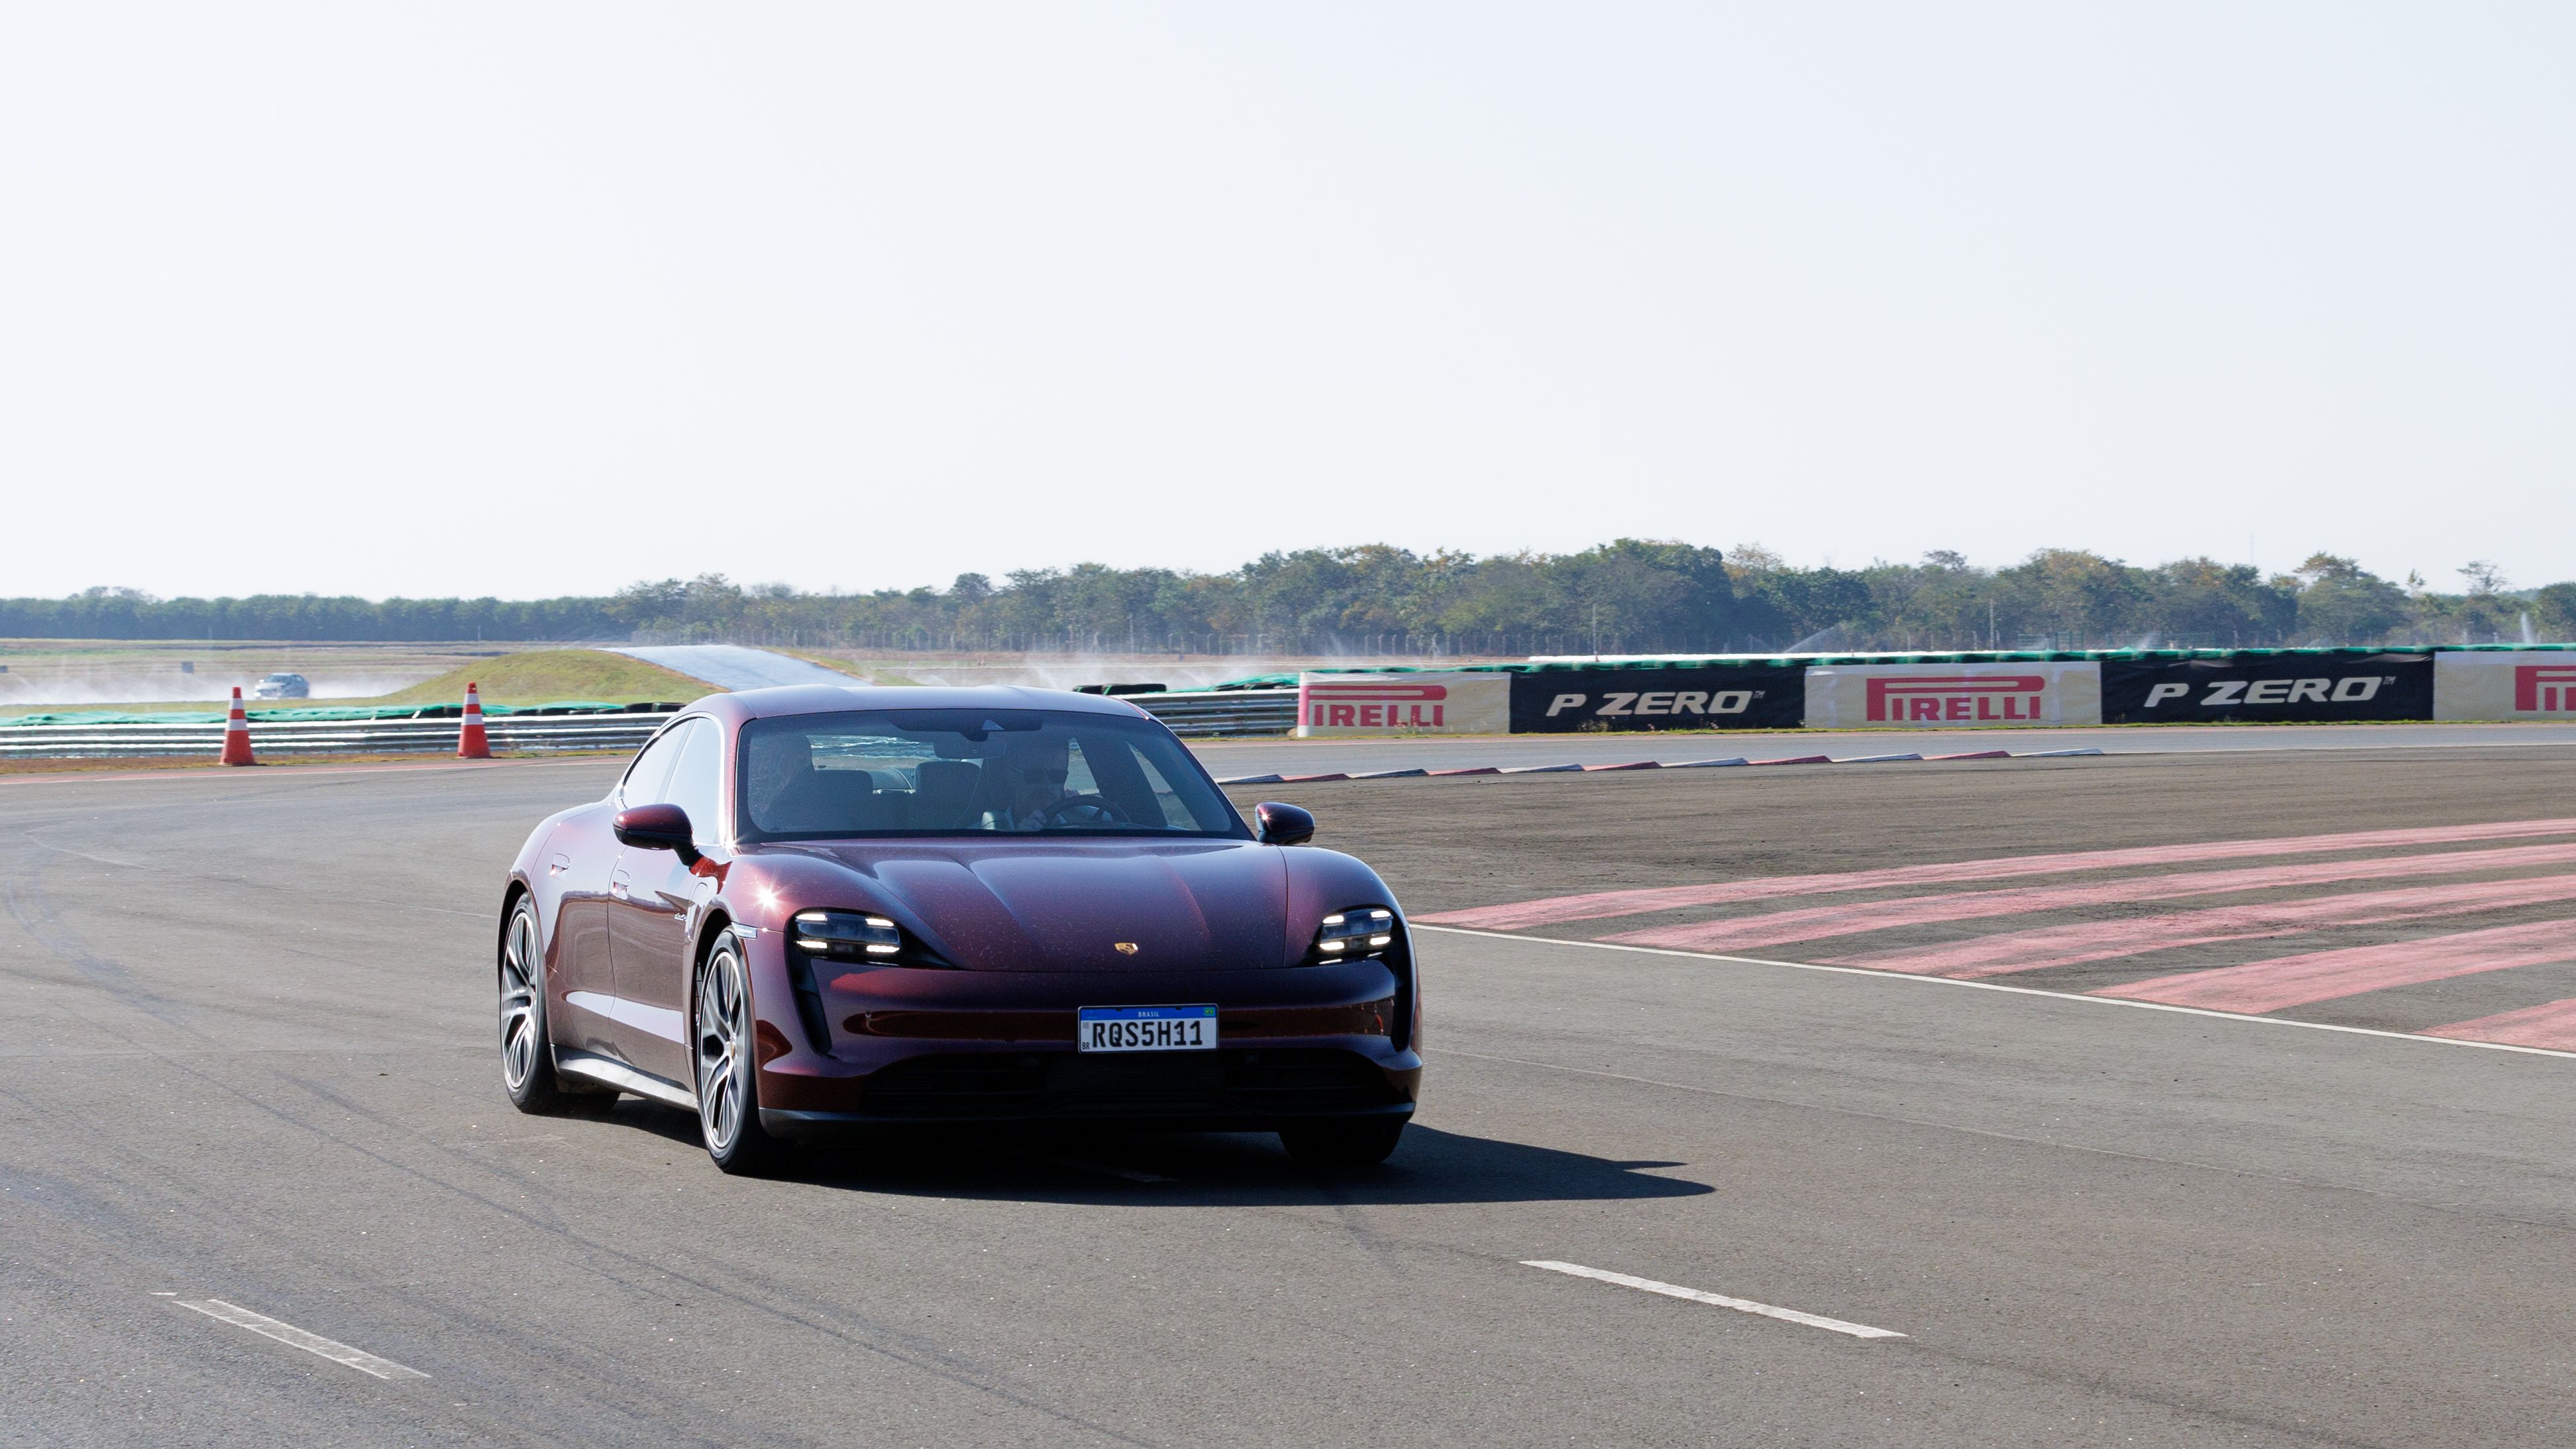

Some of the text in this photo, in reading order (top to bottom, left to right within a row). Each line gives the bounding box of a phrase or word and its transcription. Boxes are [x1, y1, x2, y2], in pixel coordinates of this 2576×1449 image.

[1298, 684, 1448, 727] PIRELLI
[1545, 693, 1587, 717] P
[1866, 675, 2045, 722] PIRELLI
[2143, 682, 2190, 708] P
[1082, 1042, 1091, 1050] BR
[1092, 1020, 1203, 1048] RQS5H11
